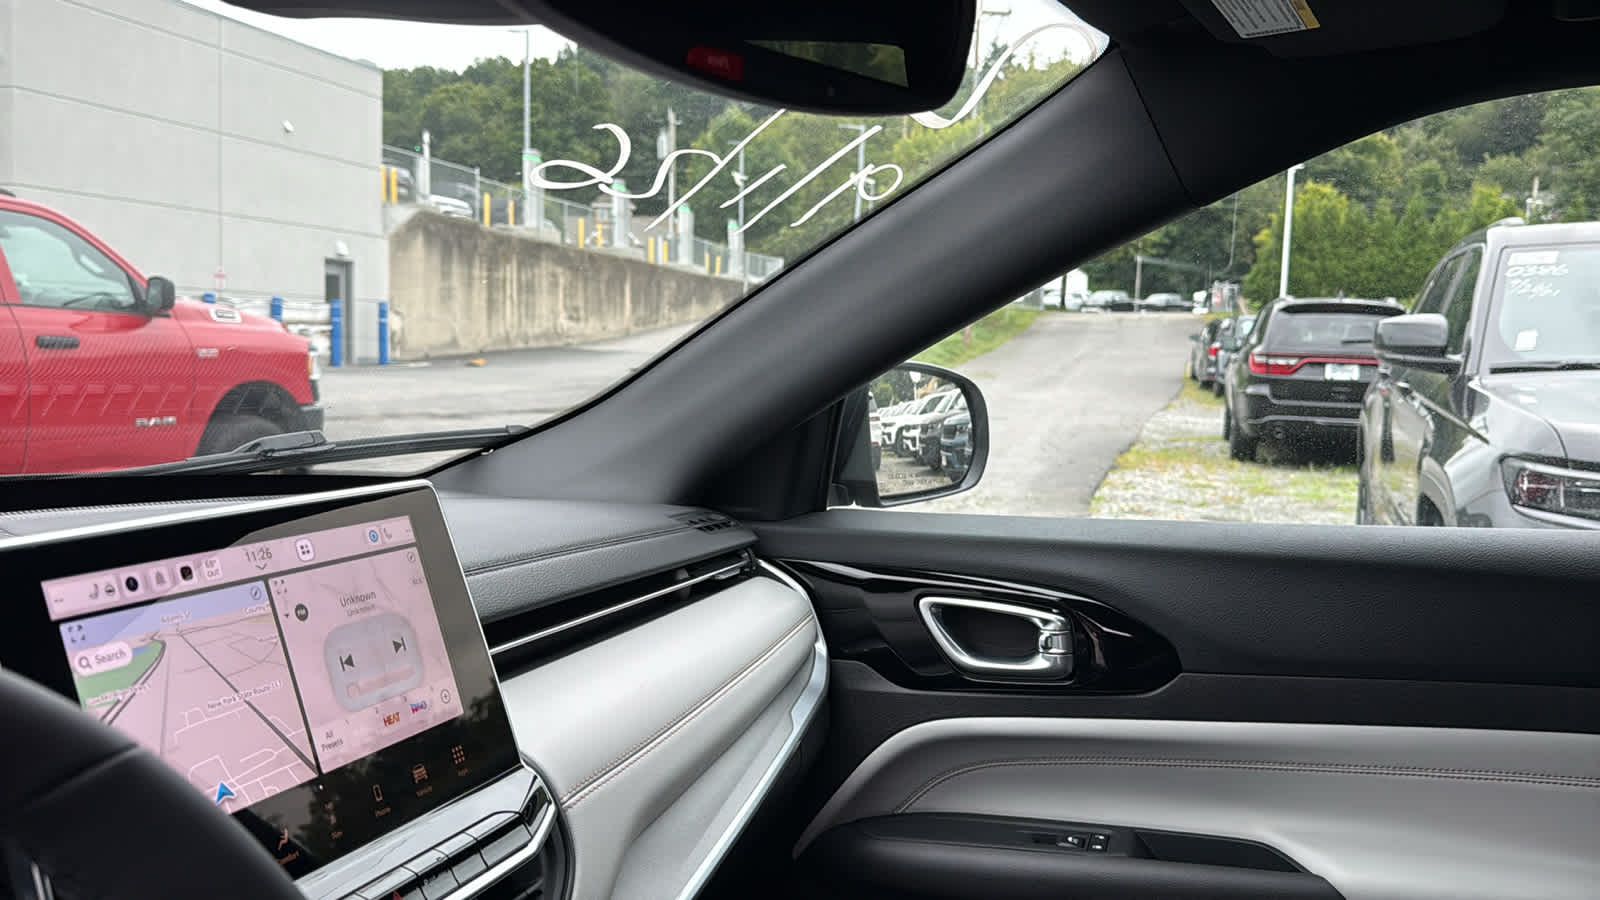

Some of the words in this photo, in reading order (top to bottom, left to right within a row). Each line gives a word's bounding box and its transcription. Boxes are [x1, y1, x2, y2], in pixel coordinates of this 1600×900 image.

[135, 416, 177, 427] RAM
[245, 547, 273, 562] 11:26
[340, 591, 376, 607] Unknown
[95, 646, 126, 662] Search
[236, 689, 253, 701] State
[252, 684, 271, 697] Route
[383, 711, 401, 727] HEAT
[321, 738, 343, 752] Presets
